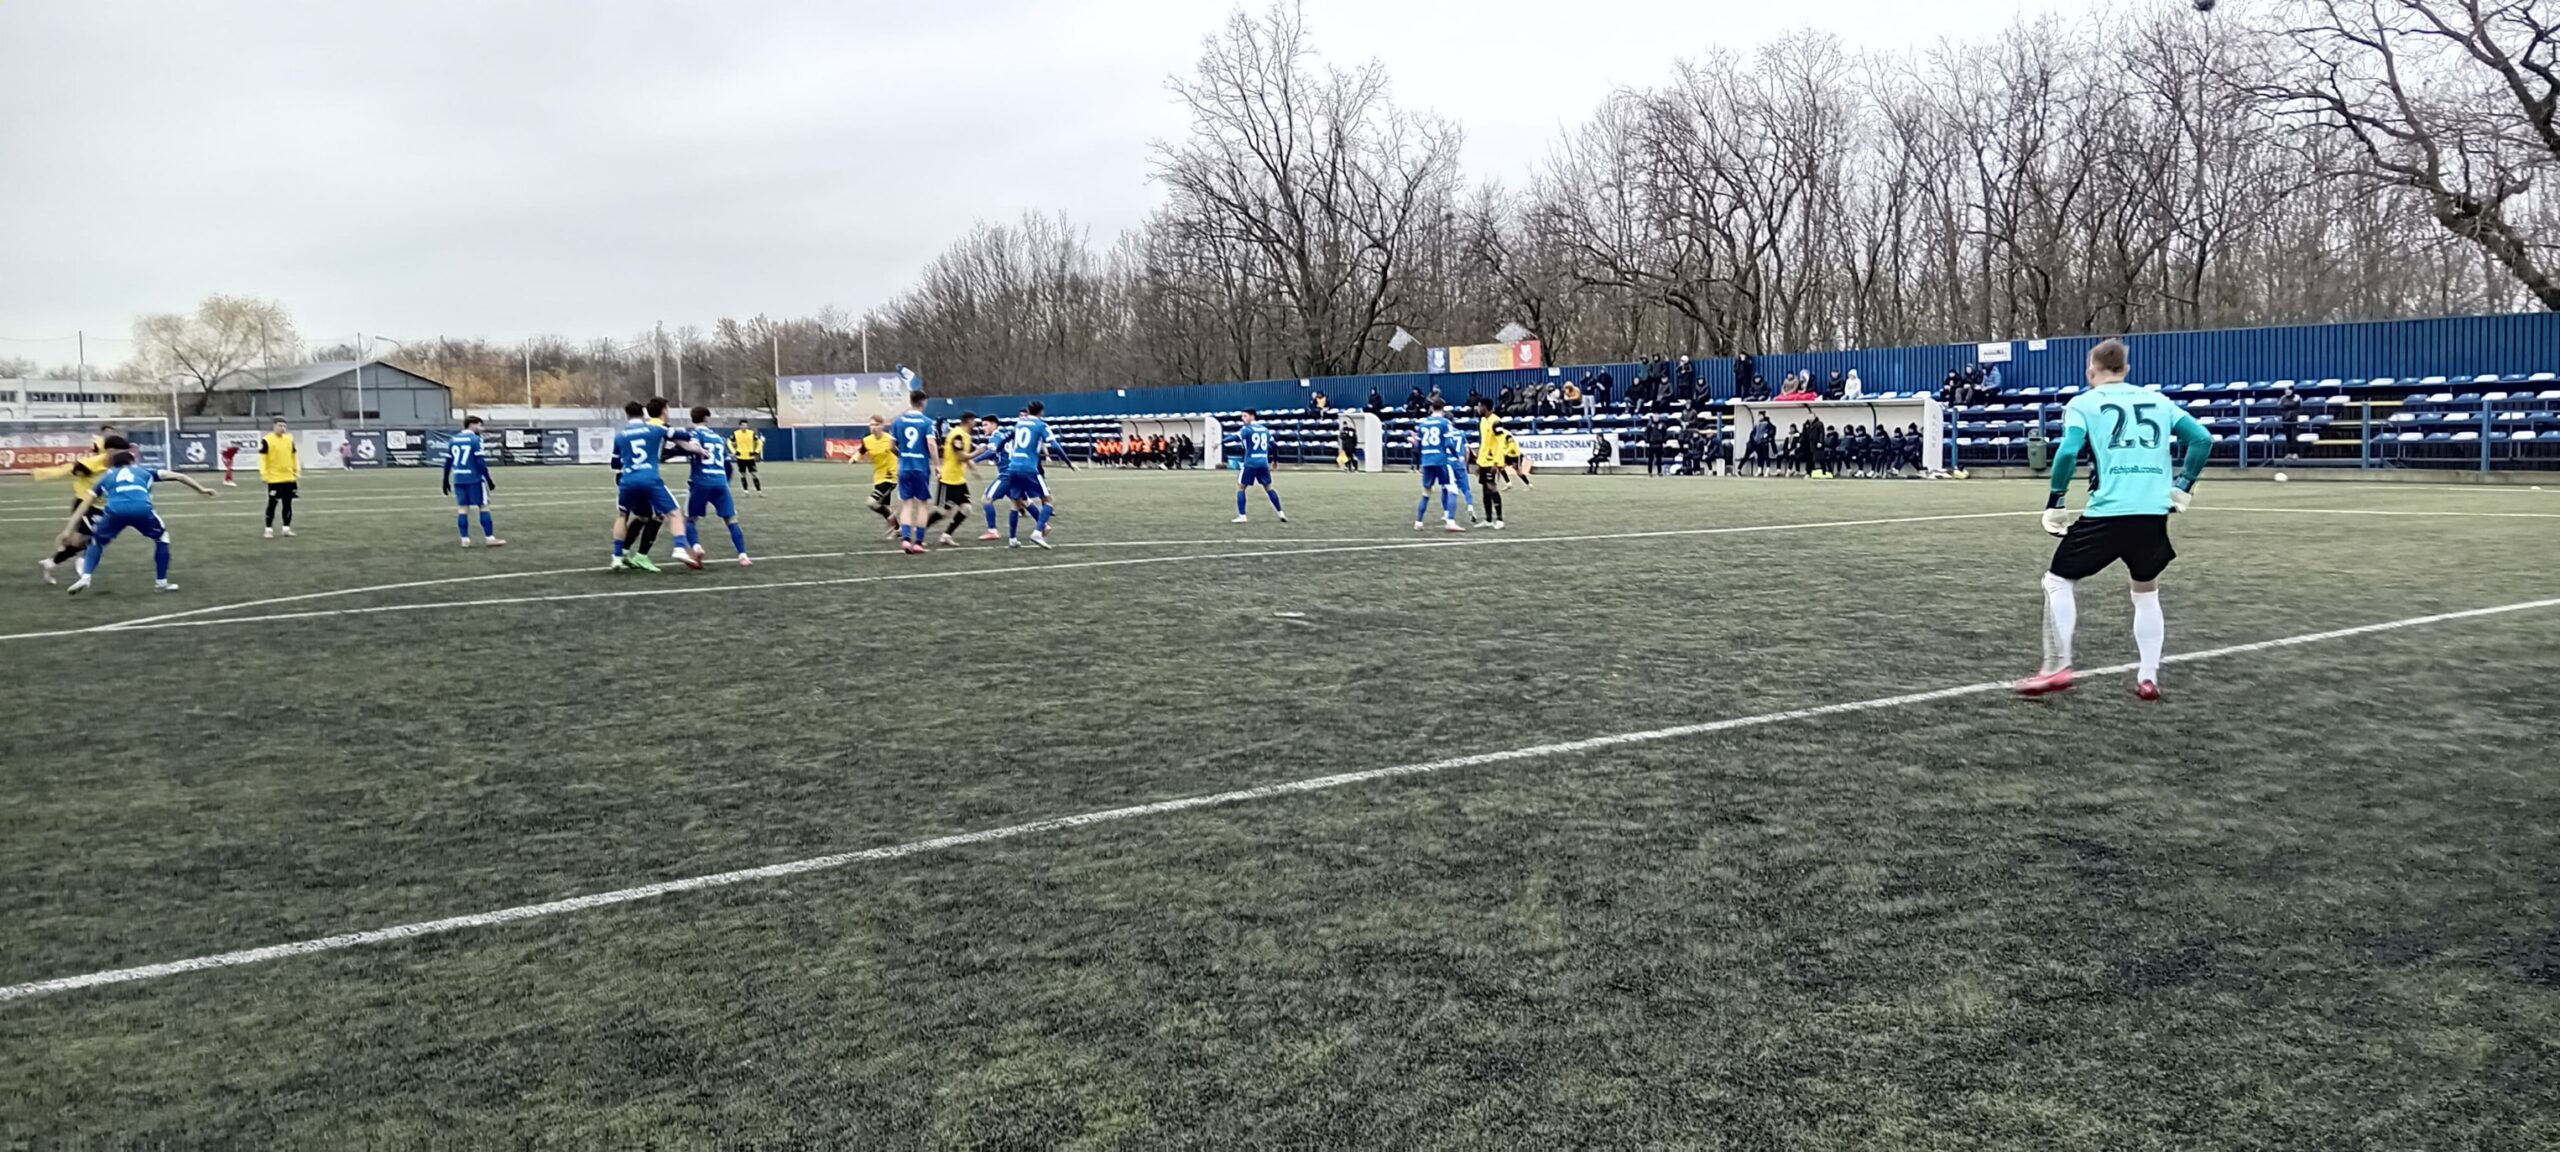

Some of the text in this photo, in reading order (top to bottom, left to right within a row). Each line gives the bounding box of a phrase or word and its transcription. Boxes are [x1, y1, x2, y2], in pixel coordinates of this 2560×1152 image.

[1420, 426, 1440, 446] 28
[2100, 403, 2161, 449] 25
[904, 427, 919, 449] 9
[1014, 427, 1032, 449] 10
[1251, 432, 1268, 451] 98
[17, 452, 52, 463] casa
[451, 445, 471, 466] 97
[630, 439, 648, 464] 5
[701, 442, 725, 468] 33
[116, 468, 135, 482] 4
